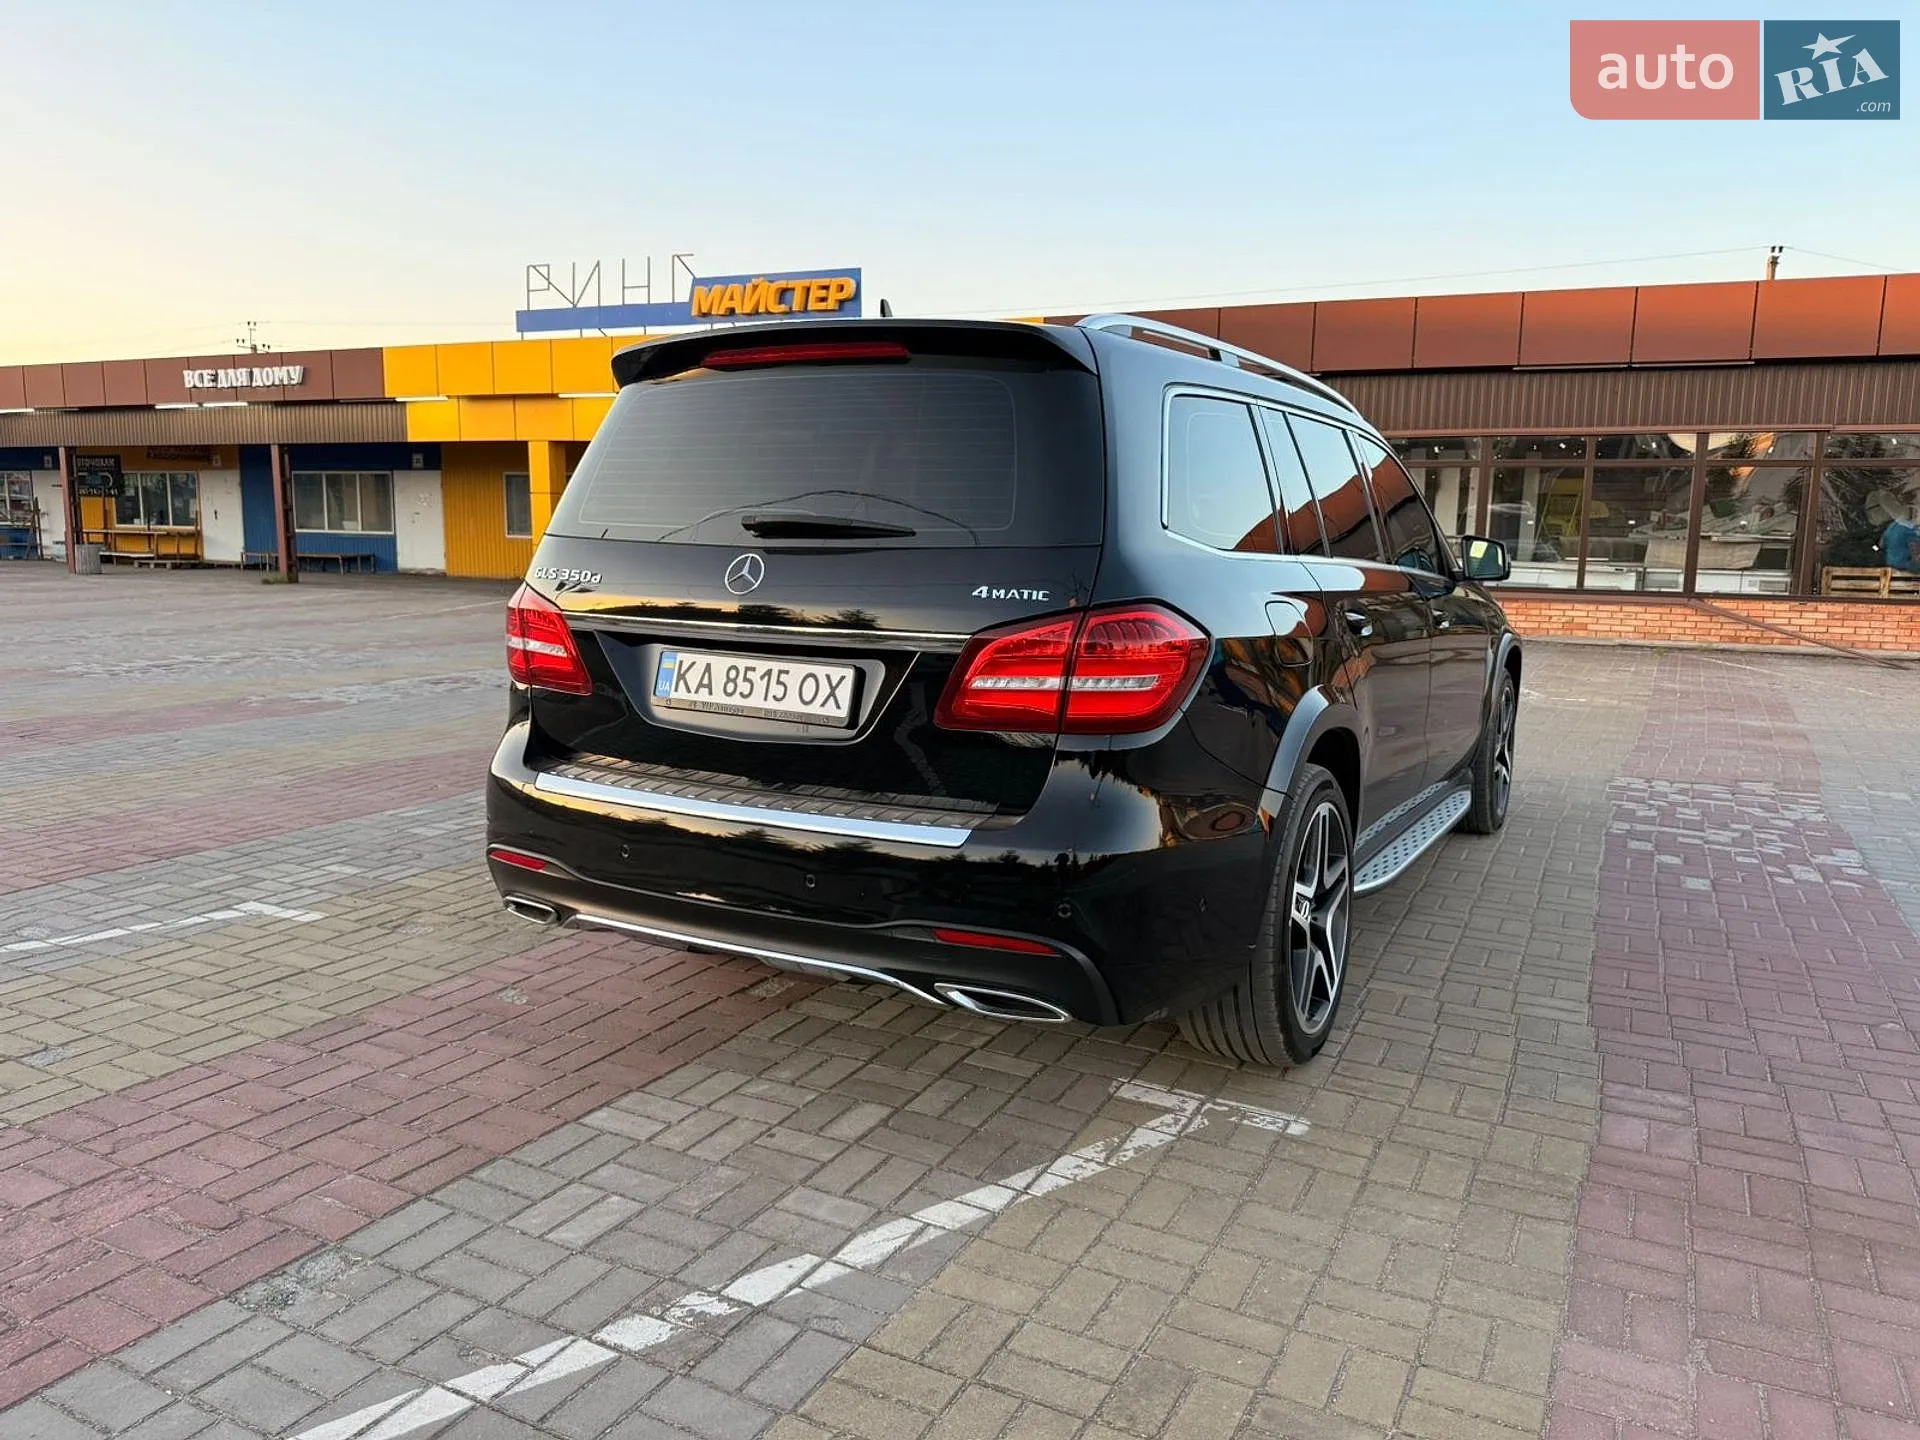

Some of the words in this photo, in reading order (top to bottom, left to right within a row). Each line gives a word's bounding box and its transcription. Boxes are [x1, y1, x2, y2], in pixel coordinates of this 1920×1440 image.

[691, 275, 857, 317] МАЙСТЕР
[183, 369, 215, 388] ВСЕ
[217, 368, 251, 388] ДЛЯ
[252, 365, 304, 387] ДОМУ
[534, 567, 558, 580] GLS
[559, 568, 602, 583] 350d
[971, 585, 1050, 601] 4MATIC
[658, 680, 671, 692] UA
[674, 659, 713, 696] KA
[722, 664, 790, 702] 8515
[798, 672, 846, 710] OX
